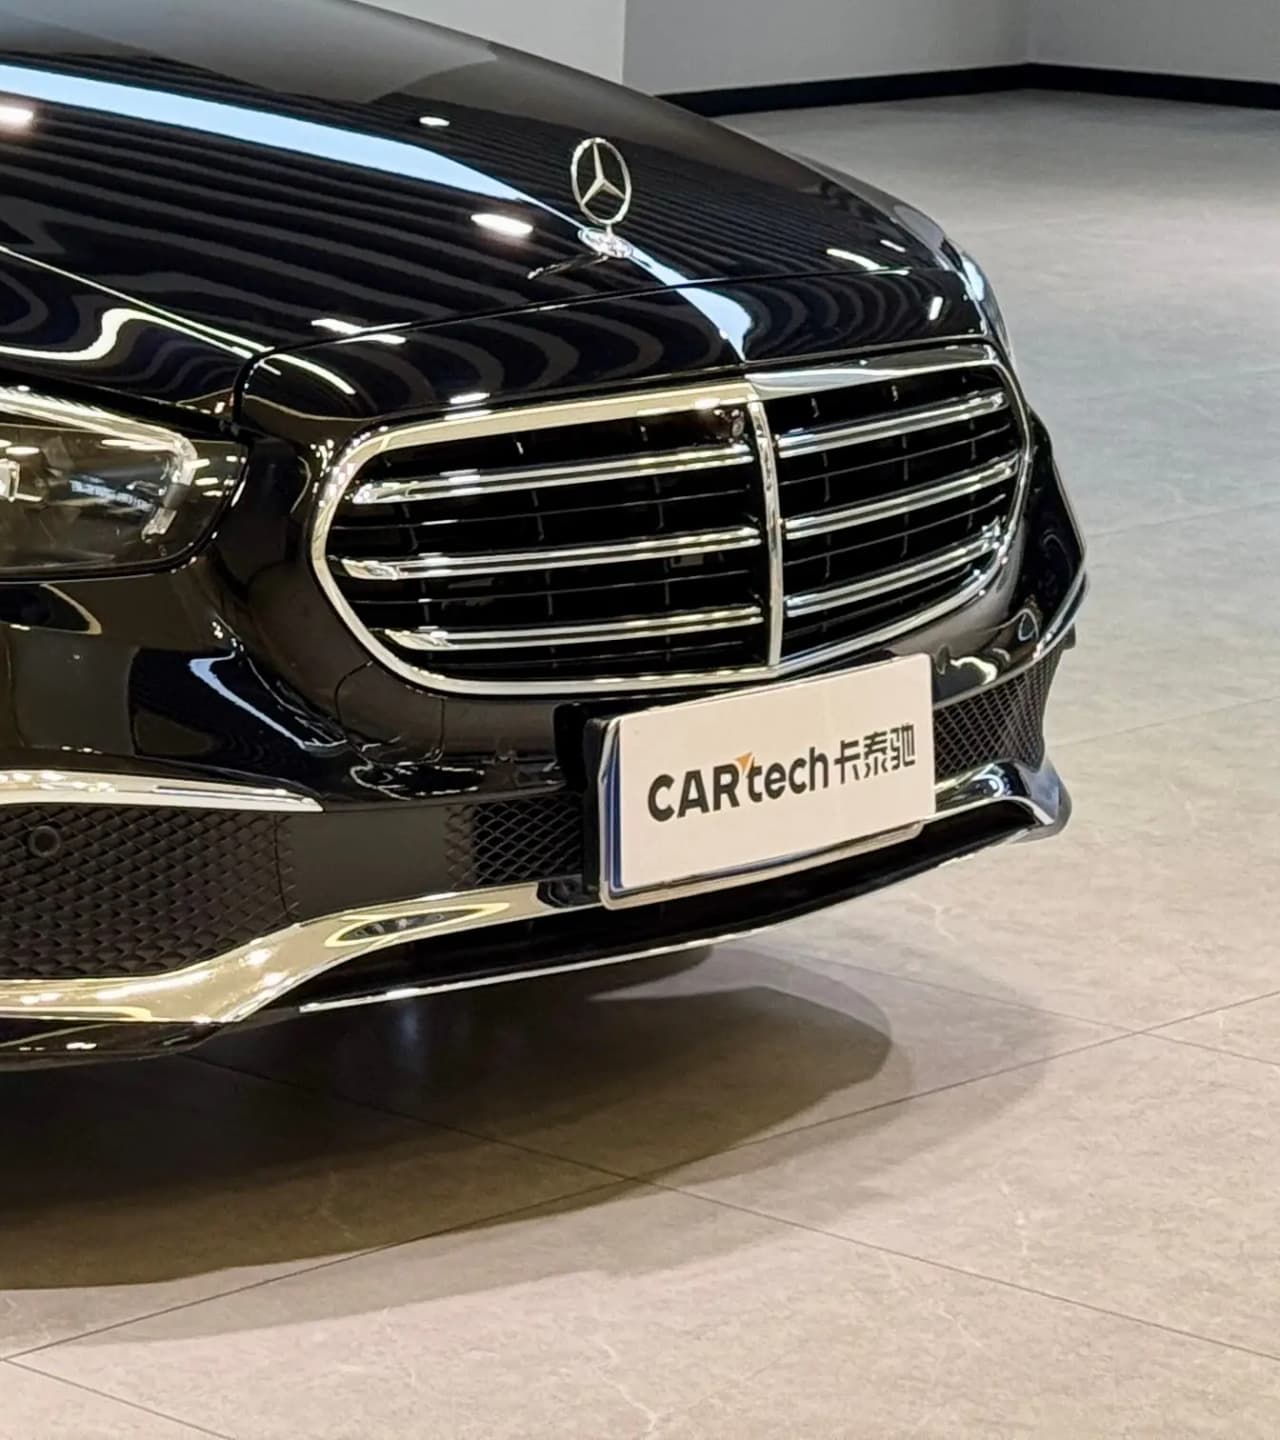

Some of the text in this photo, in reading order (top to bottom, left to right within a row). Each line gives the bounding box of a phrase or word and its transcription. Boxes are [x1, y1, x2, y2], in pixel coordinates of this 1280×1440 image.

[647, 722, 916, 822] CARtech 卡泰驰
